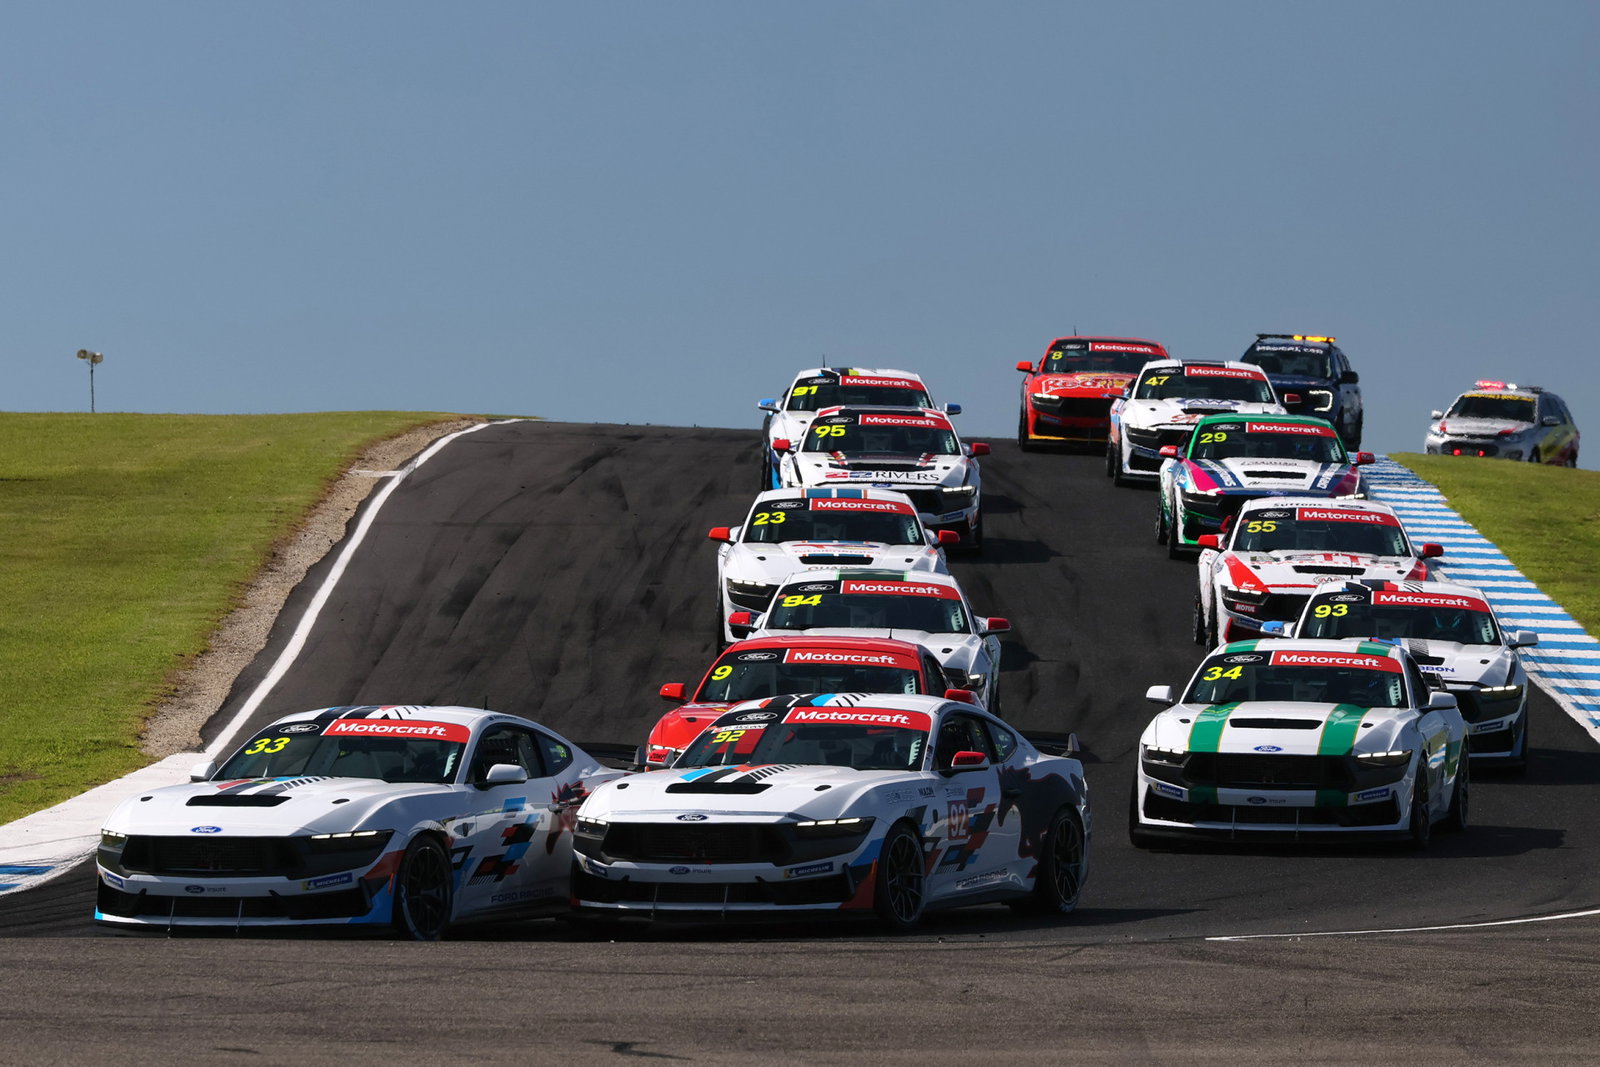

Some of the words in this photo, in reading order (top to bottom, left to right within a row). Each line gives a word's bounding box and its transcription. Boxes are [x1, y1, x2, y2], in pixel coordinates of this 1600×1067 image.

[1094, 343, 1153, 353] Motorcraft
[1052, 351, 1063, 360] 8
[1191, 367, 1253, 378] Motorcraft
[845, 377, 912, 388] Motorcraft
[1145, 376, 1170, 387] 47
[792, 385, 818, 397] 91
[865, 415, 936, 427] Motorcraft
[815, 425, 846, 438] 95
[1252, 422, 1324, 435] Motorcraft
[1200, 432, 1227, 444] 29
[875, 471, 939, 481] RIVERS
[817, 500, 899, 511] Motorcraft
[753, 511, 786, 526] 23
[1304, 510, 1383, 522] Motorcraft
[1247, 520, 1277, 533] 55
[849, 583, 942, 595] Motorcraft
[782, 594, 822, 608] 94
[1380, 593, 1471, 607] Motorcraft
[1314, 603, 1348, 618] 93
[794, 651, 897, 665] Motorcraft
[1279, 654, 1380, 668] Motorcraft
[711, 665, 733, 681] 9
[1203, 665, 1243, 681] 34
[794, 709, 910, 725] Motorcraft
[334, 720, 448, 737] Motorcraft
[712, 729, 746, 744] 92
[244, 736, 291, 755] 33
[950, 803, 968, 838] 92
